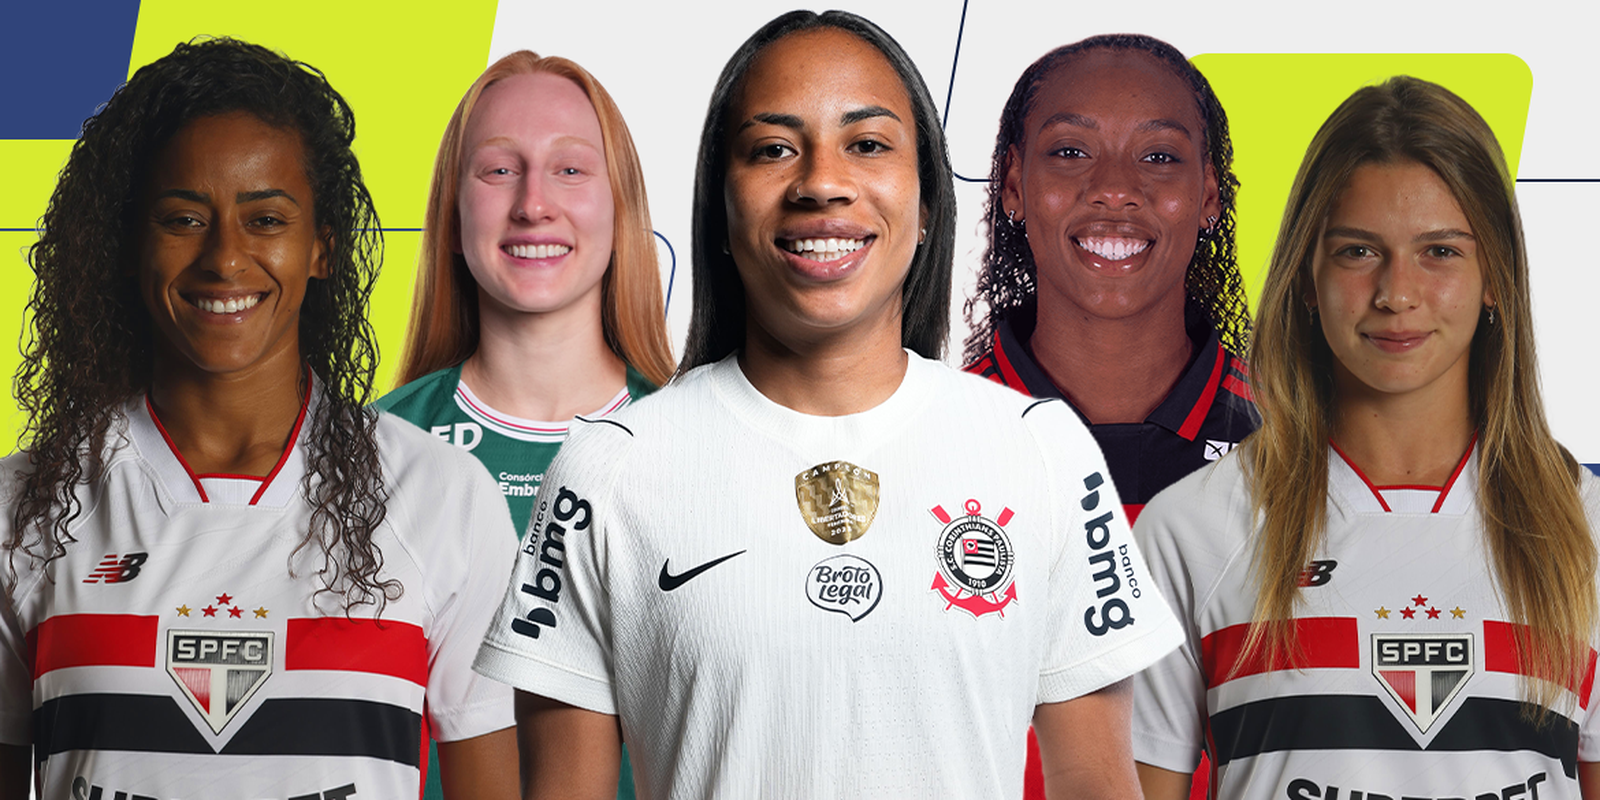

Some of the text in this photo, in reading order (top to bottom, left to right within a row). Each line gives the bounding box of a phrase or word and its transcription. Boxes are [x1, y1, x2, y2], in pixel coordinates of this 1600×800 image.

[520, 485, 593, 603] bmg
[522, 500, 548, 557] banco
[945, 523, 993, 553] CORINTHIANS
[993, 535, 1007, 575] PAULISTA
[815, 564, 871, 584] Broto
[968, 578, 987, 588] 1910
[1084, 510, 1135, 637] bmg
[1118, 543, 1142, 600] banco
[819, 582, 874, 605] Legal
[176, 639, 264, 661] SPFC
[1381, 642, 1464, 664] SPFC
